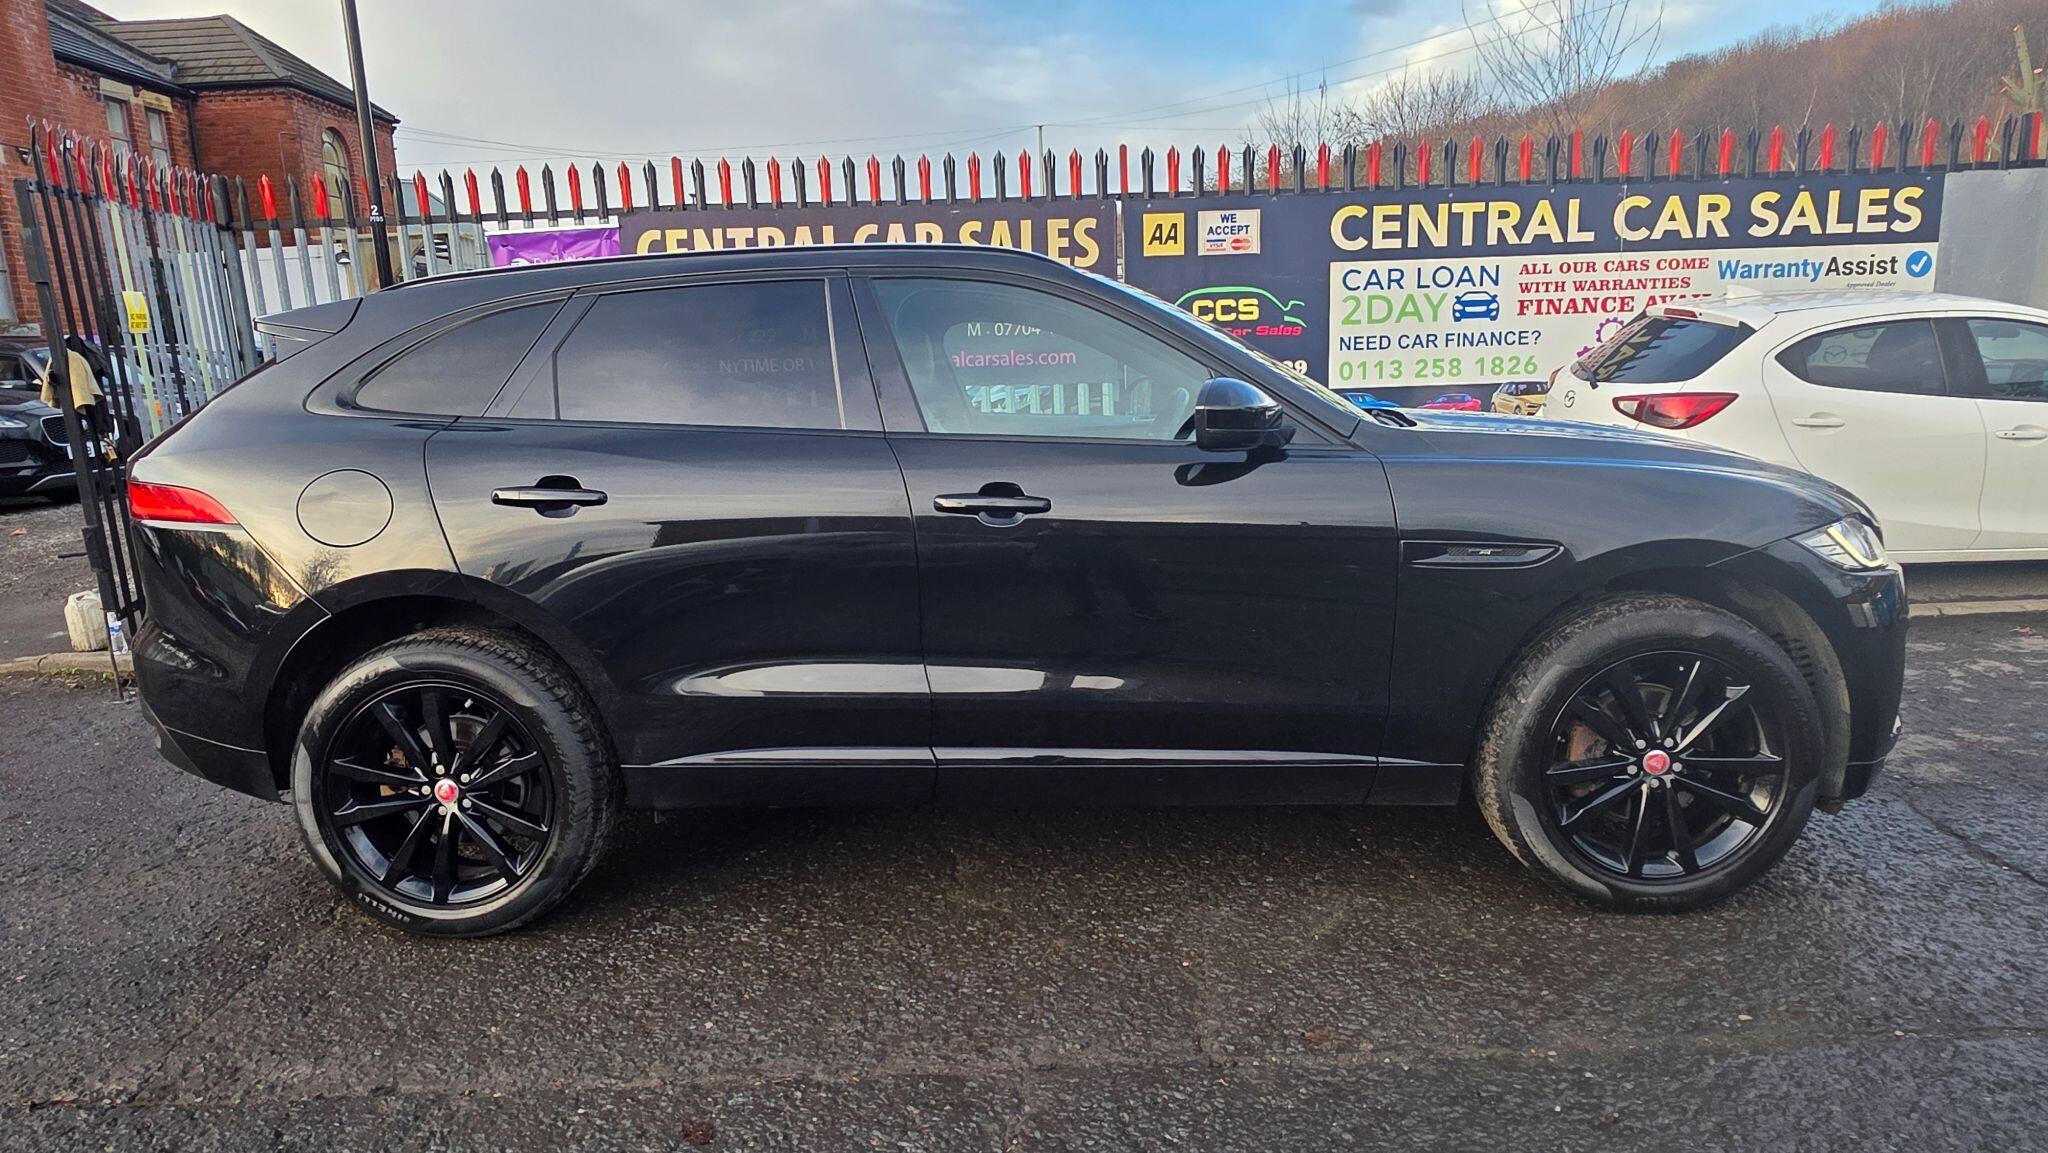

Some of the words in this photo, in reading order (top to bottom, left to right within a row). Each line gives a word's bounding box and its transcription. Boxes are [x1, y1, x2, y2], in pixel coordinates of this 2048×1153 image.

[370, 204, 379, 216] 2
[1220, 213, 1237, 223] WE
[1330, 198, 1595, 251] CENTRAL
[1612, 194, 1731, 241] CAR
[1747, 186, 1925, 238] SALES
[1148, 222, 1178, 246] AA
[1207, 225, 1250, 236] ACCEPT
[1518, 263, 1552, 275] ALL
[1559, 261, 1597, 274] OUR
[1603, 259, 1650, 273] CARS
[1656, 257, 1709, 270] COME
[1342, 267, 1405, 291] CAR
[1416, 265, 1500, 289] LOAN
[1518, 281, 1566, 294] WITH
[1572, 277, 1691, 292] WARRANTIES
[1192, 298, 1260, 322] CCS
[1341, 292, 1449, 326] 2DAY
[1517, 296, 1635, 316] FINANCE
[1255, 324, 1302, 336] Sales
[1339, 335, 1392, 351] NEED
[1398, 334, 1438, 349] CAR
[1445, 330, 1542, 348] FINANCE?
[1339, 359, 1403, 381] 0113
[1414, 357, 1462, 379] 258
[1475, 355, 1538, 377] 1826
